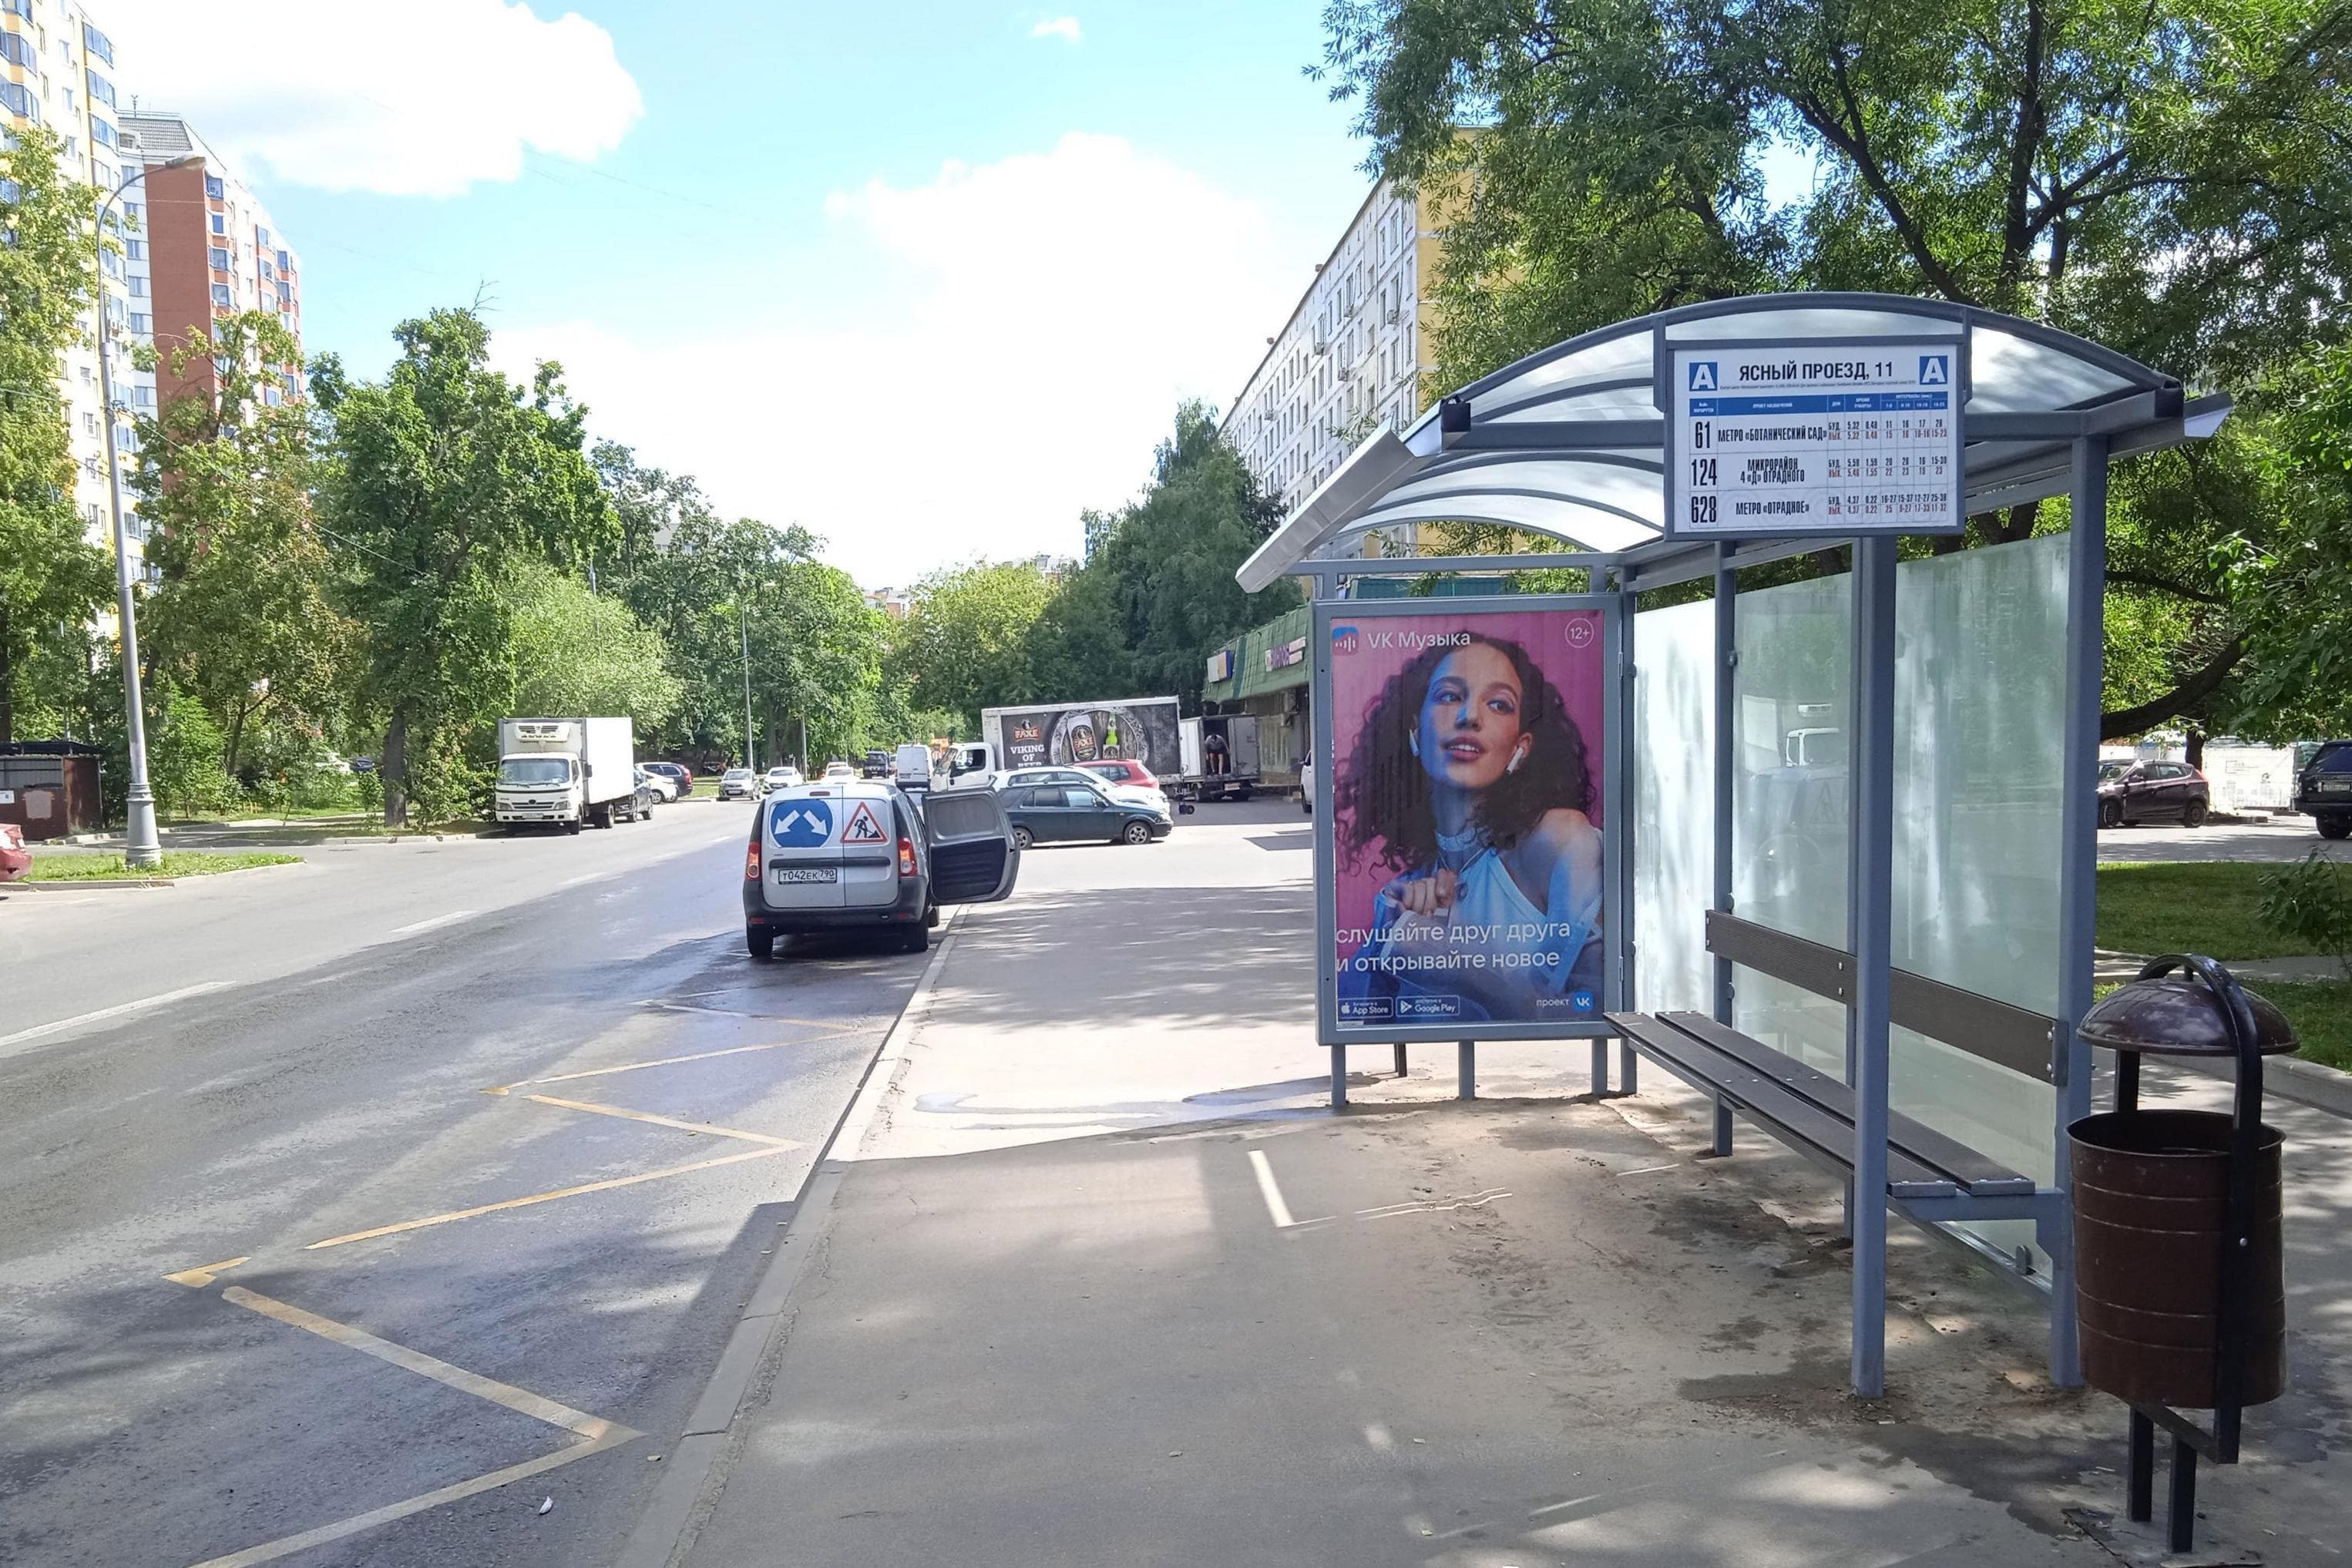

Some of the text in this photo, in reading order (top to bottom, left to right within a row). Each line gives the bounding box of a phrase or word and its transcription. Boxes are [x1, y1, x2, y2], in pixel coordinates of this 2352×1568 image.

[1739, 360, 1893, 381] ЯСНЫЙ ПРОЕЗД, 11
[1695, 421, 1710, 448] 61
[1718, 425, 1827, 442] МЕТРО «БОТАНИЧЕСКИЙ САД»
[1691, 458, 1717, 486] 124
[1747, 456, 1798, 472] МИКРОРАЙОН
[1740, 469, 1805, 485] 4 «Д» ОТРАДНОГО
[1691, 495, 1717, 523] 628
[1735, 500, 1809, 515] МЕТРО «ОТРАДНОЕ»
[1367, 630, 1471, 651] VK Музыка
[1570, 626, 1590, 640] 12+
[1014, 729, 1039, 739] FAXE
[1010, 744, 1045, 754] VIKING
[1022, 754, 1035, 762] OF
[1336, 923, 1571, 948] слушайте друг друга
[1337, 950, 1561, 975] и открывайте новое
[1352, 1006, 1389, 1016] App Store
[1414, 1003, 1456, 1013] Google Play
[1536, 998, 1570, 1009] проект
